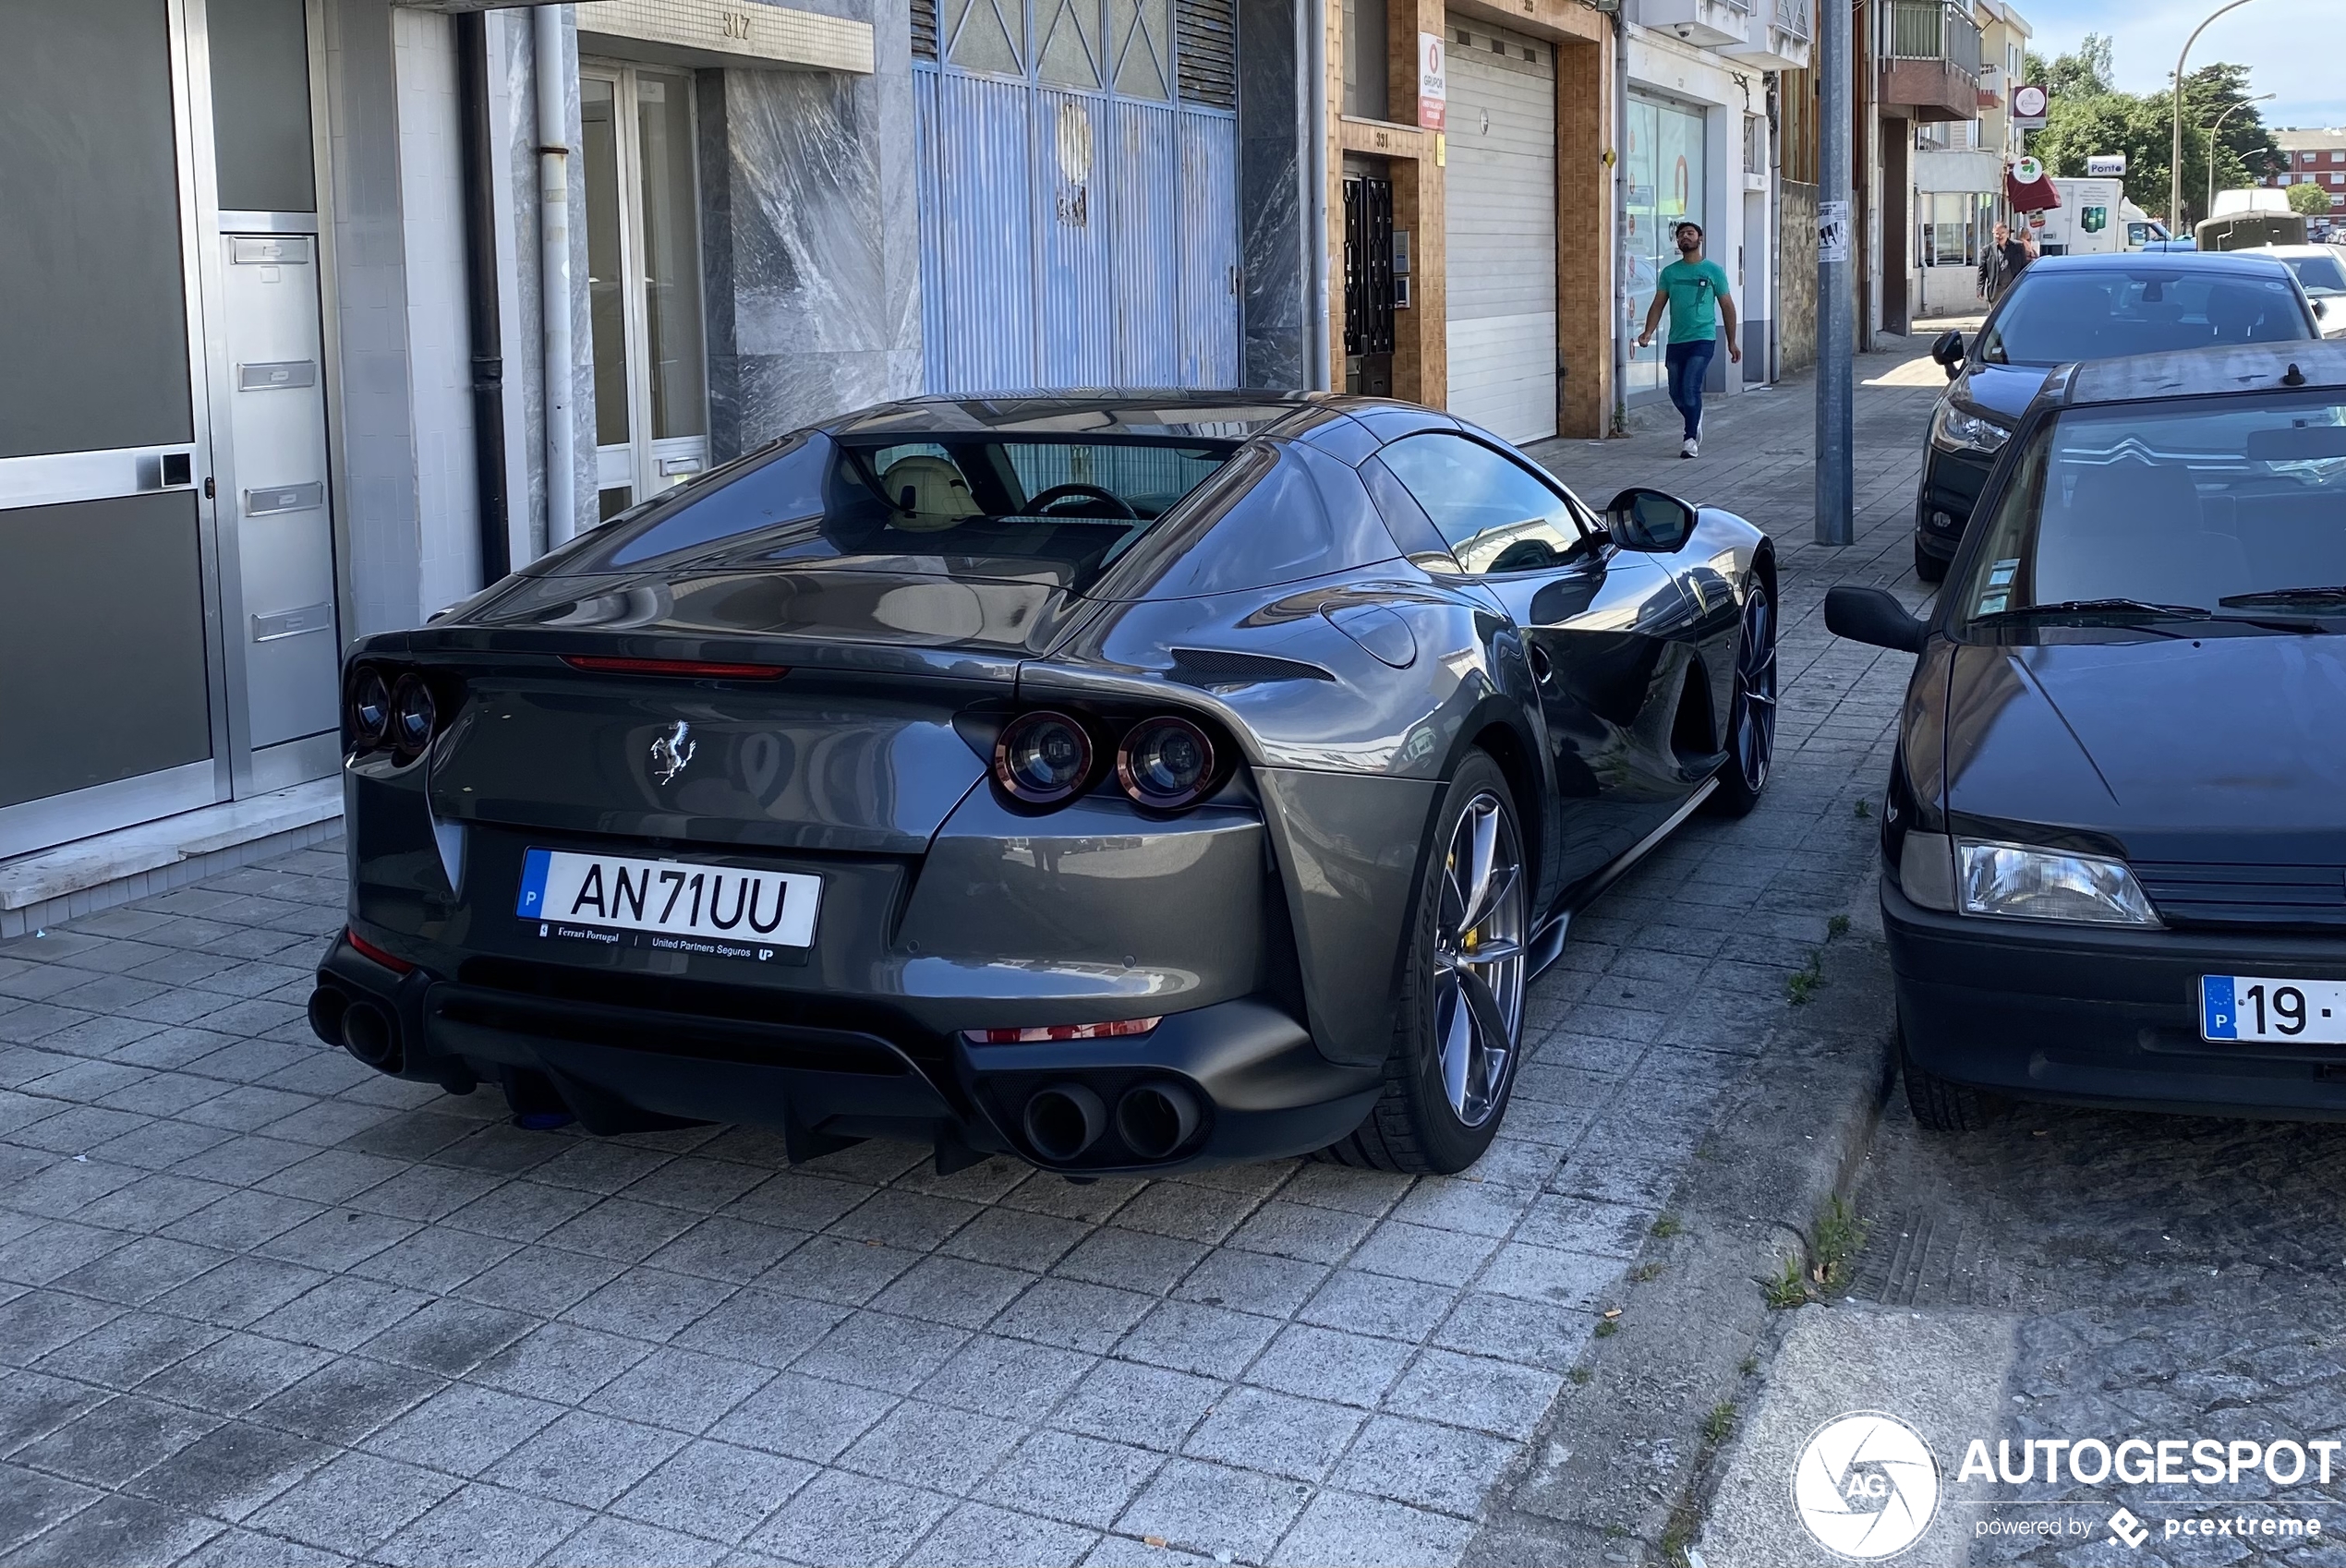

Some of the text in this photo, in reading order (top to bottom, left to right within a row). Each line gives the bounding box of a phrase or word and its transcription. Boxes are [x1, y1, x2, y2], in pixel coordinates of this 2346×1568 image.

[723, 11, 750, 40] 317
[1376, 132, 1388, 148] 331
[526, 891, 537, 906] P
[558, 927, 619, 944] Ferrari Portugal
[652, 937, 751, 957] United Partners Seguros
[2216, 1014, 2228, 1028] P
